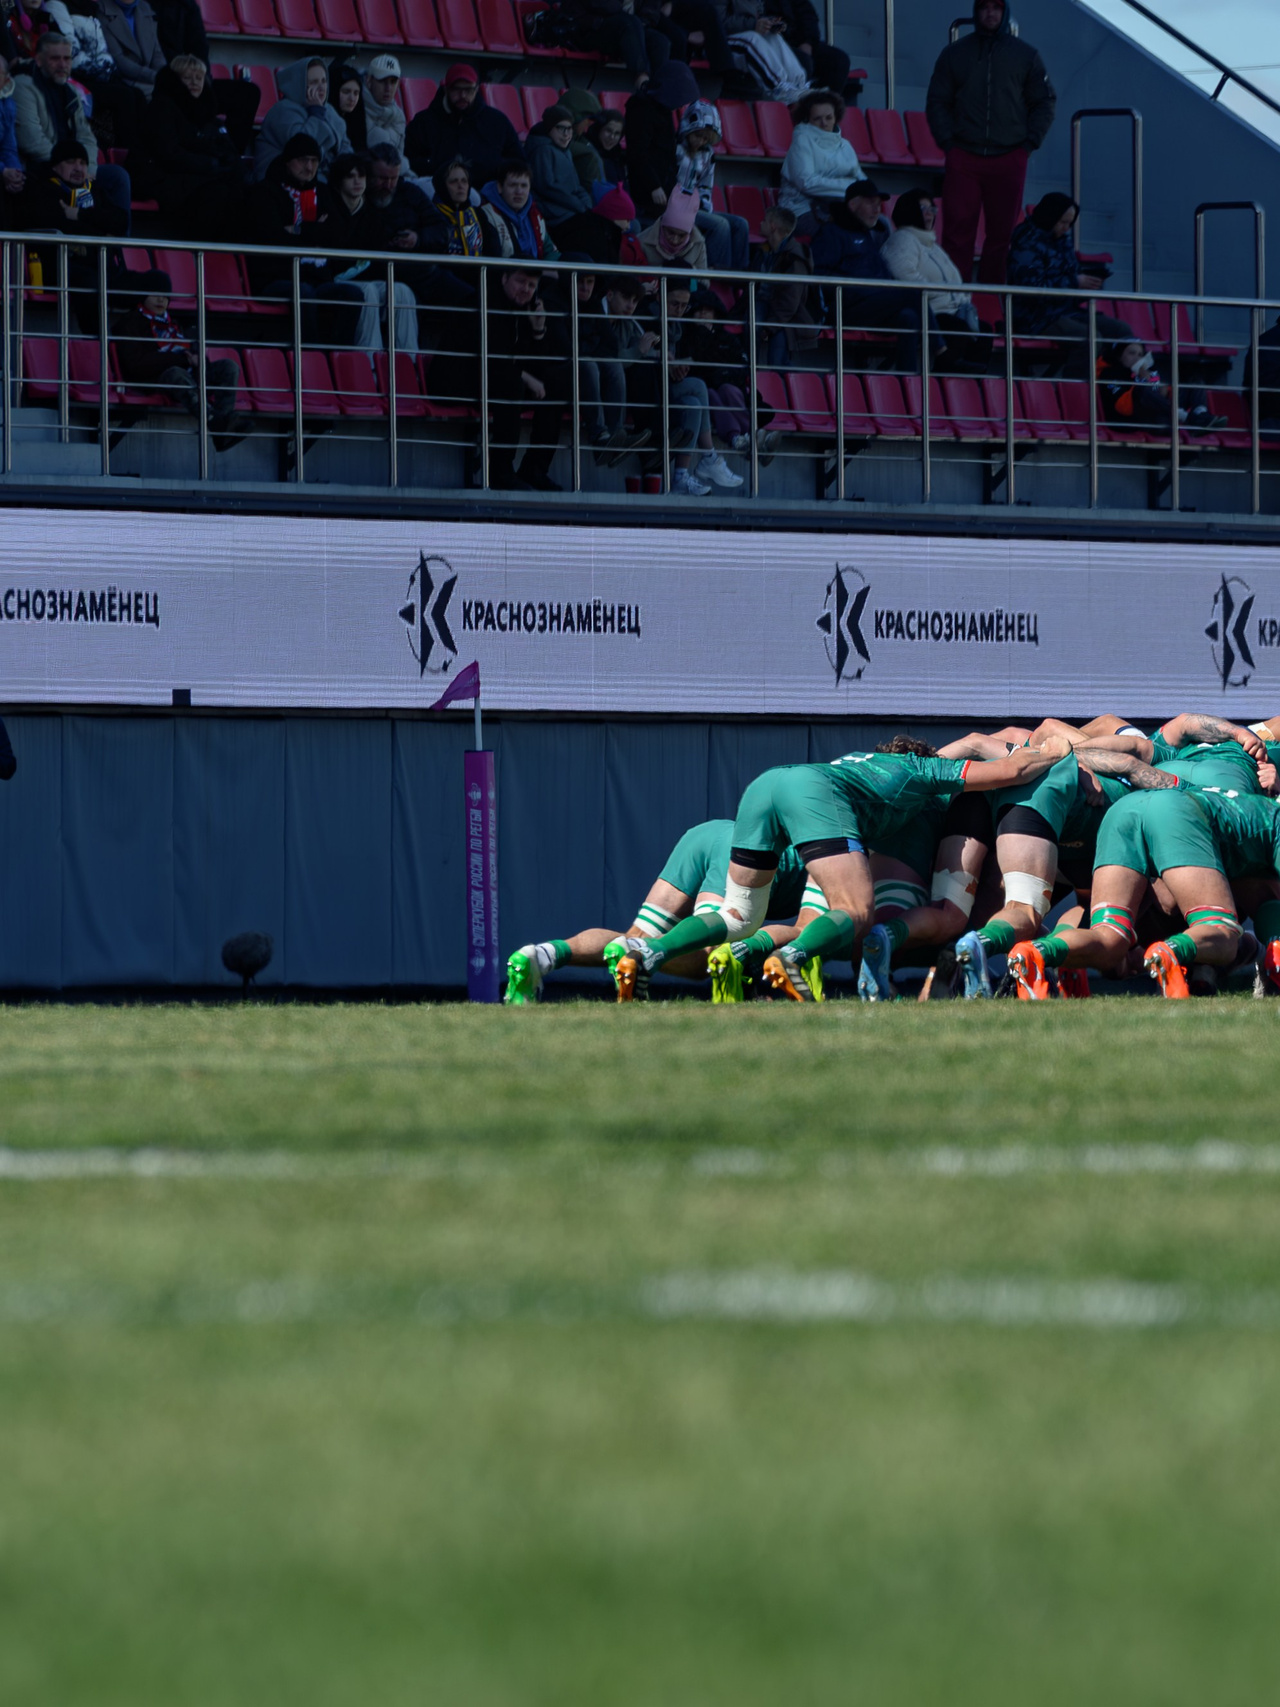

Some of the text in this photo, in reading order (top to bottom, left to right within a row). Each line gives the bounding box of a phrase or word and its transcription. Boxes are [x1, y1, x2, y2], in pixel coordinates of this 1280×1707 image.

[0, 585, 160, 629] СНОЗНАМЁНЕЦ
[462, 598, 641, 638] КРАСНОЗНАМЁНЕЦ
[874, 607, 1039, 646] КРАСНОЗНАМЁНЕЦ
[471, 808, 486, 948] СУПЕРКУБОК РОССИИ ПО РЕГБИ
